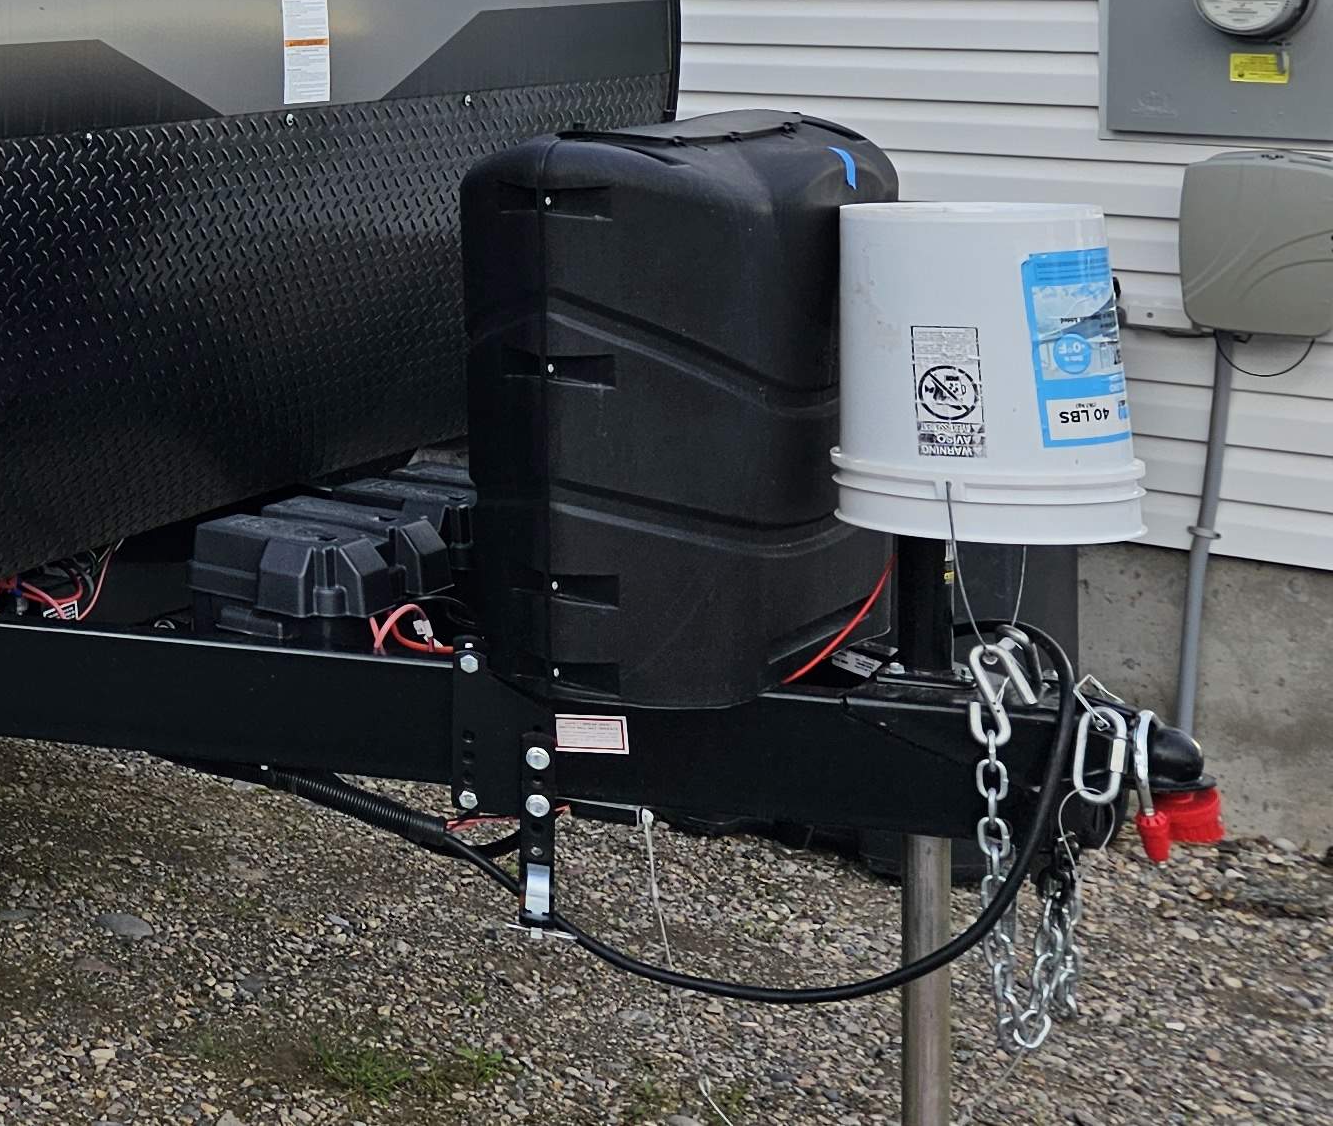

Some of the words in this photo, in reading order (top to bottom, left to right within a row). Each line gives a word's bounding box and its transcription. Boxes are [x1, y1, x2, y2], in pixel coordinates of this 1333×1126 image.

[1059, 409, 1090, 423] LBS
[1094, 408, 1110, 420] 40
[936, 434, 972, 444] AVISO
[921, 445, 973, 456] WARNING
